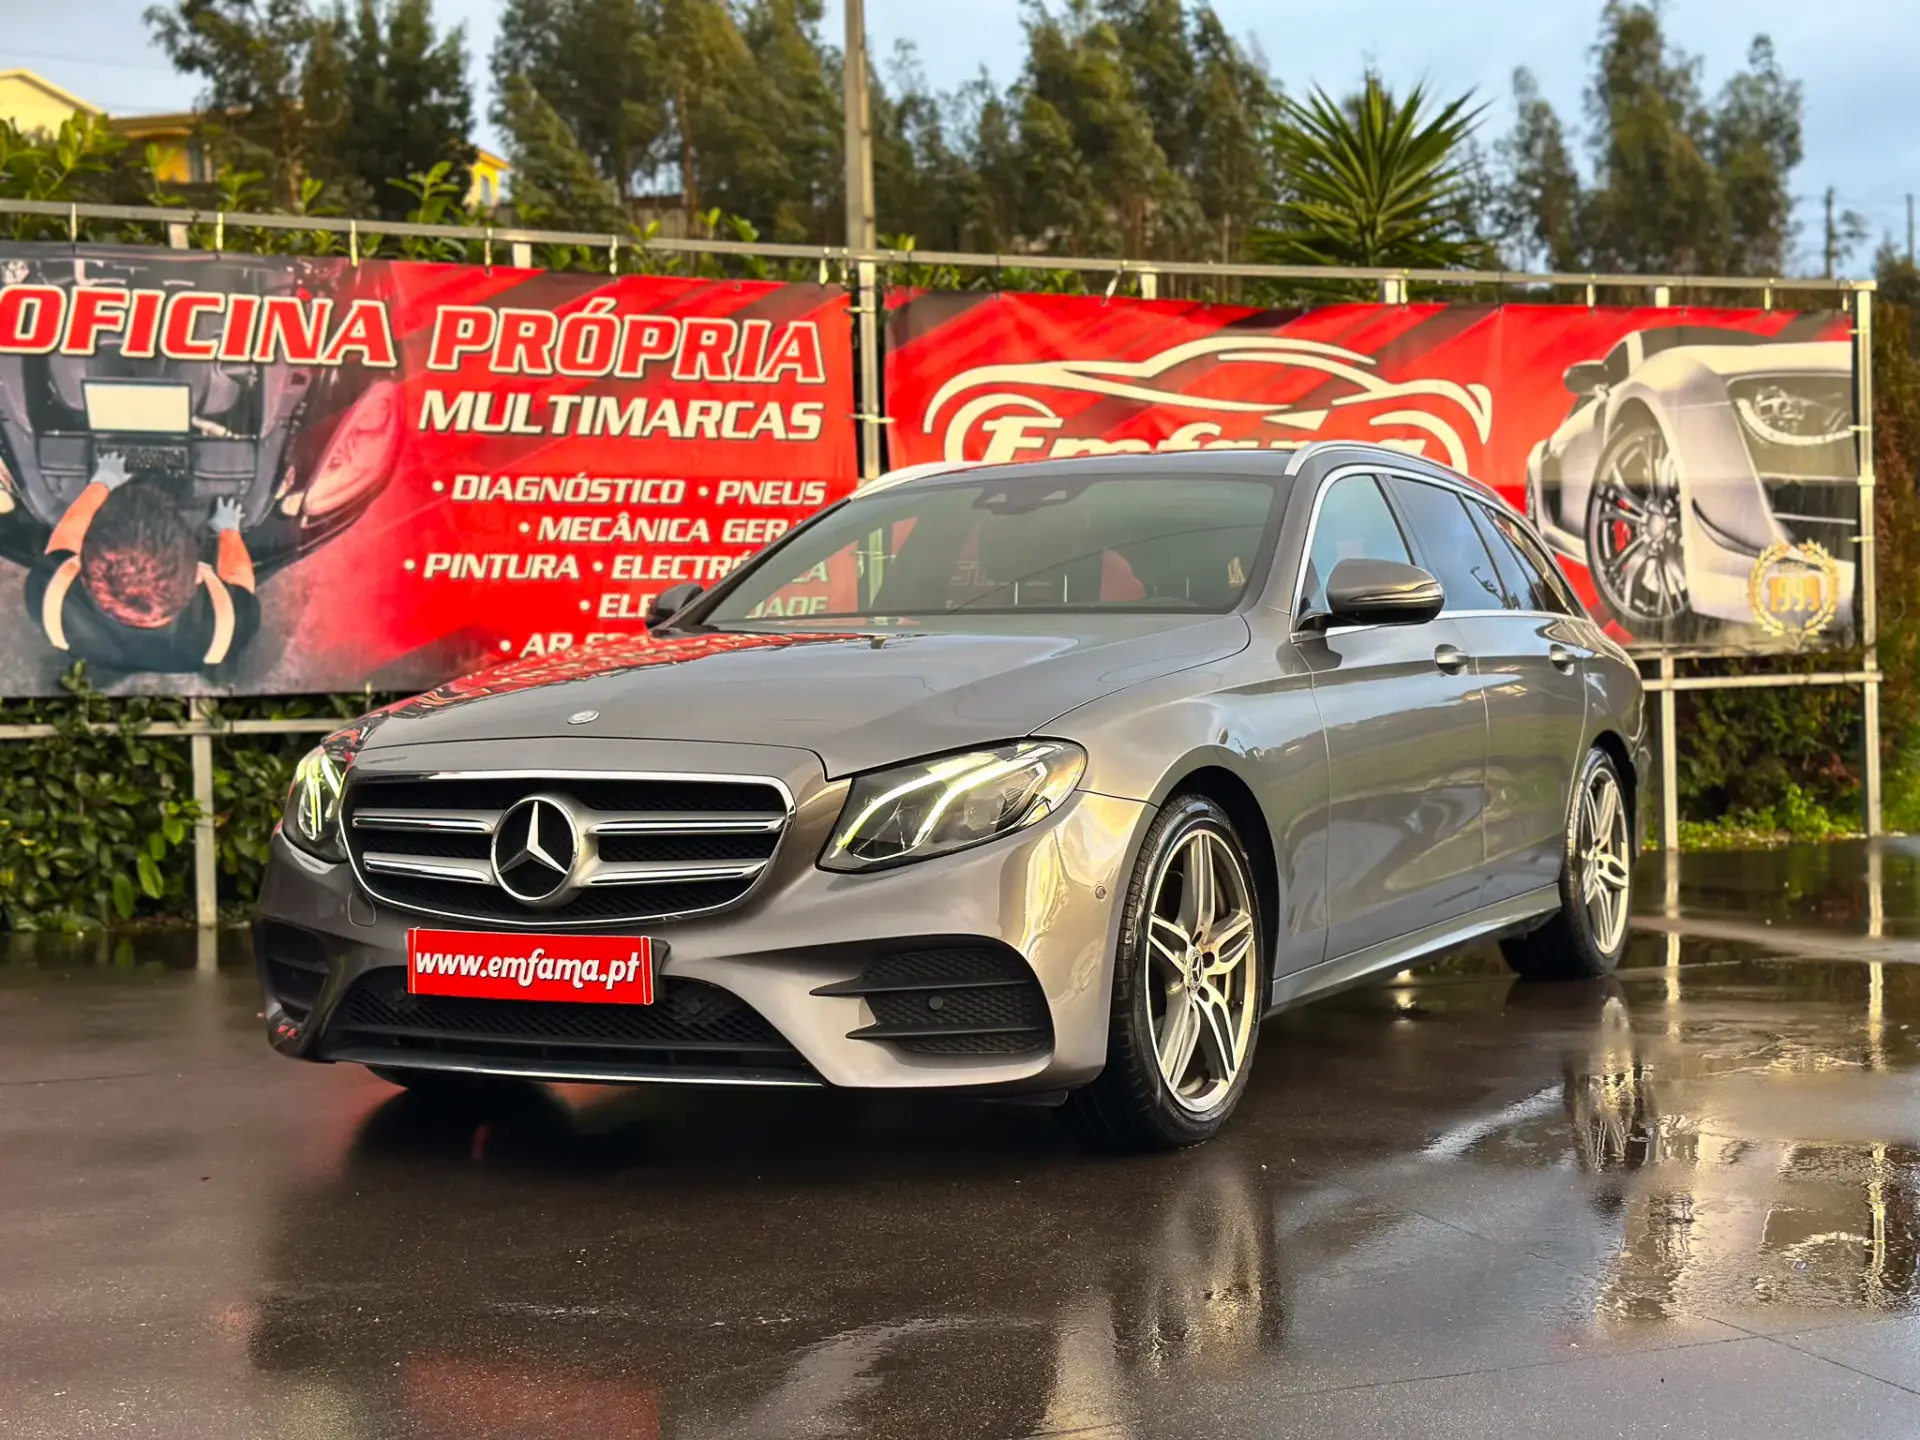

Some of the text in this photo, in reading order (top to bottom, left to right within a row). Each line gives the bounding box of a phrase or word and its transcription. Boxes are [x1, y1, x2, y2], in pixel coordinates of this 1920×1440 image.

[0, 284, 826, 384] OFICINA PRÓPRIA
[418, 390, 825, 440] MULTIMARCAS
[451, 472, 827, 506] DIAGNÓSTICO PNEUS
[538, 511, 803, 543] MECÂNICA GER
[423, 552, 580, 580] PINTURA
[519, 631, 574, 659] AR
[415, 948, 640, 990] www.emfama.pt
